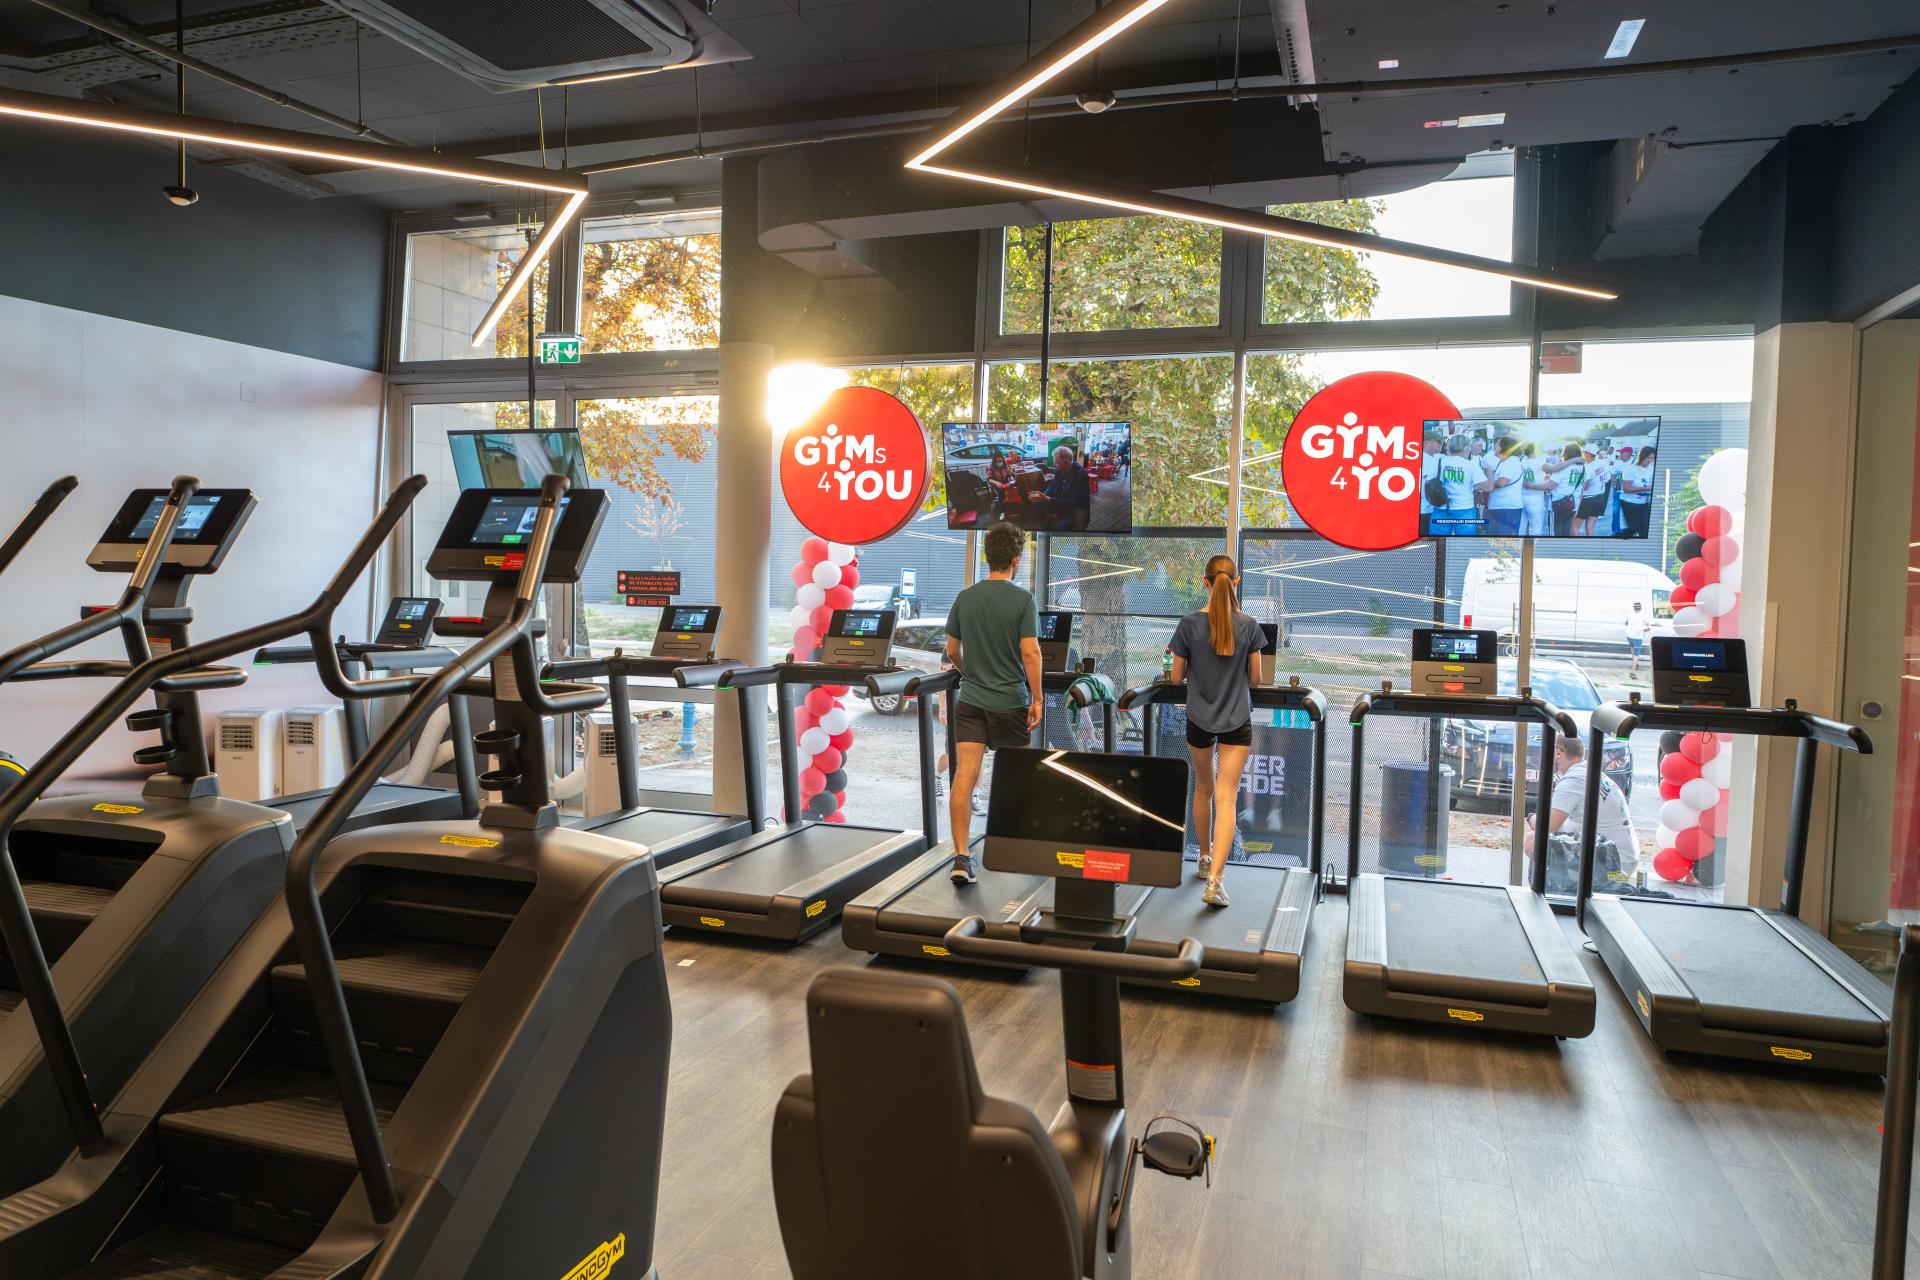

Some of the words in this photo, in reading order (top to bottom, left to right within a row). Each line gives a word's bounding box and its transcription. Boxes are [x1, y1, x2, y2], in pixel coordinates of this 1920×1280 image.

[817, 471, 831, 493] 4
[834, 459, 913, 501] YOU
[1330, 466, 1347, 490] 4
[1351, 453, 1421, 501] YO
[567, 1239, 623, 1280] NOGYM
